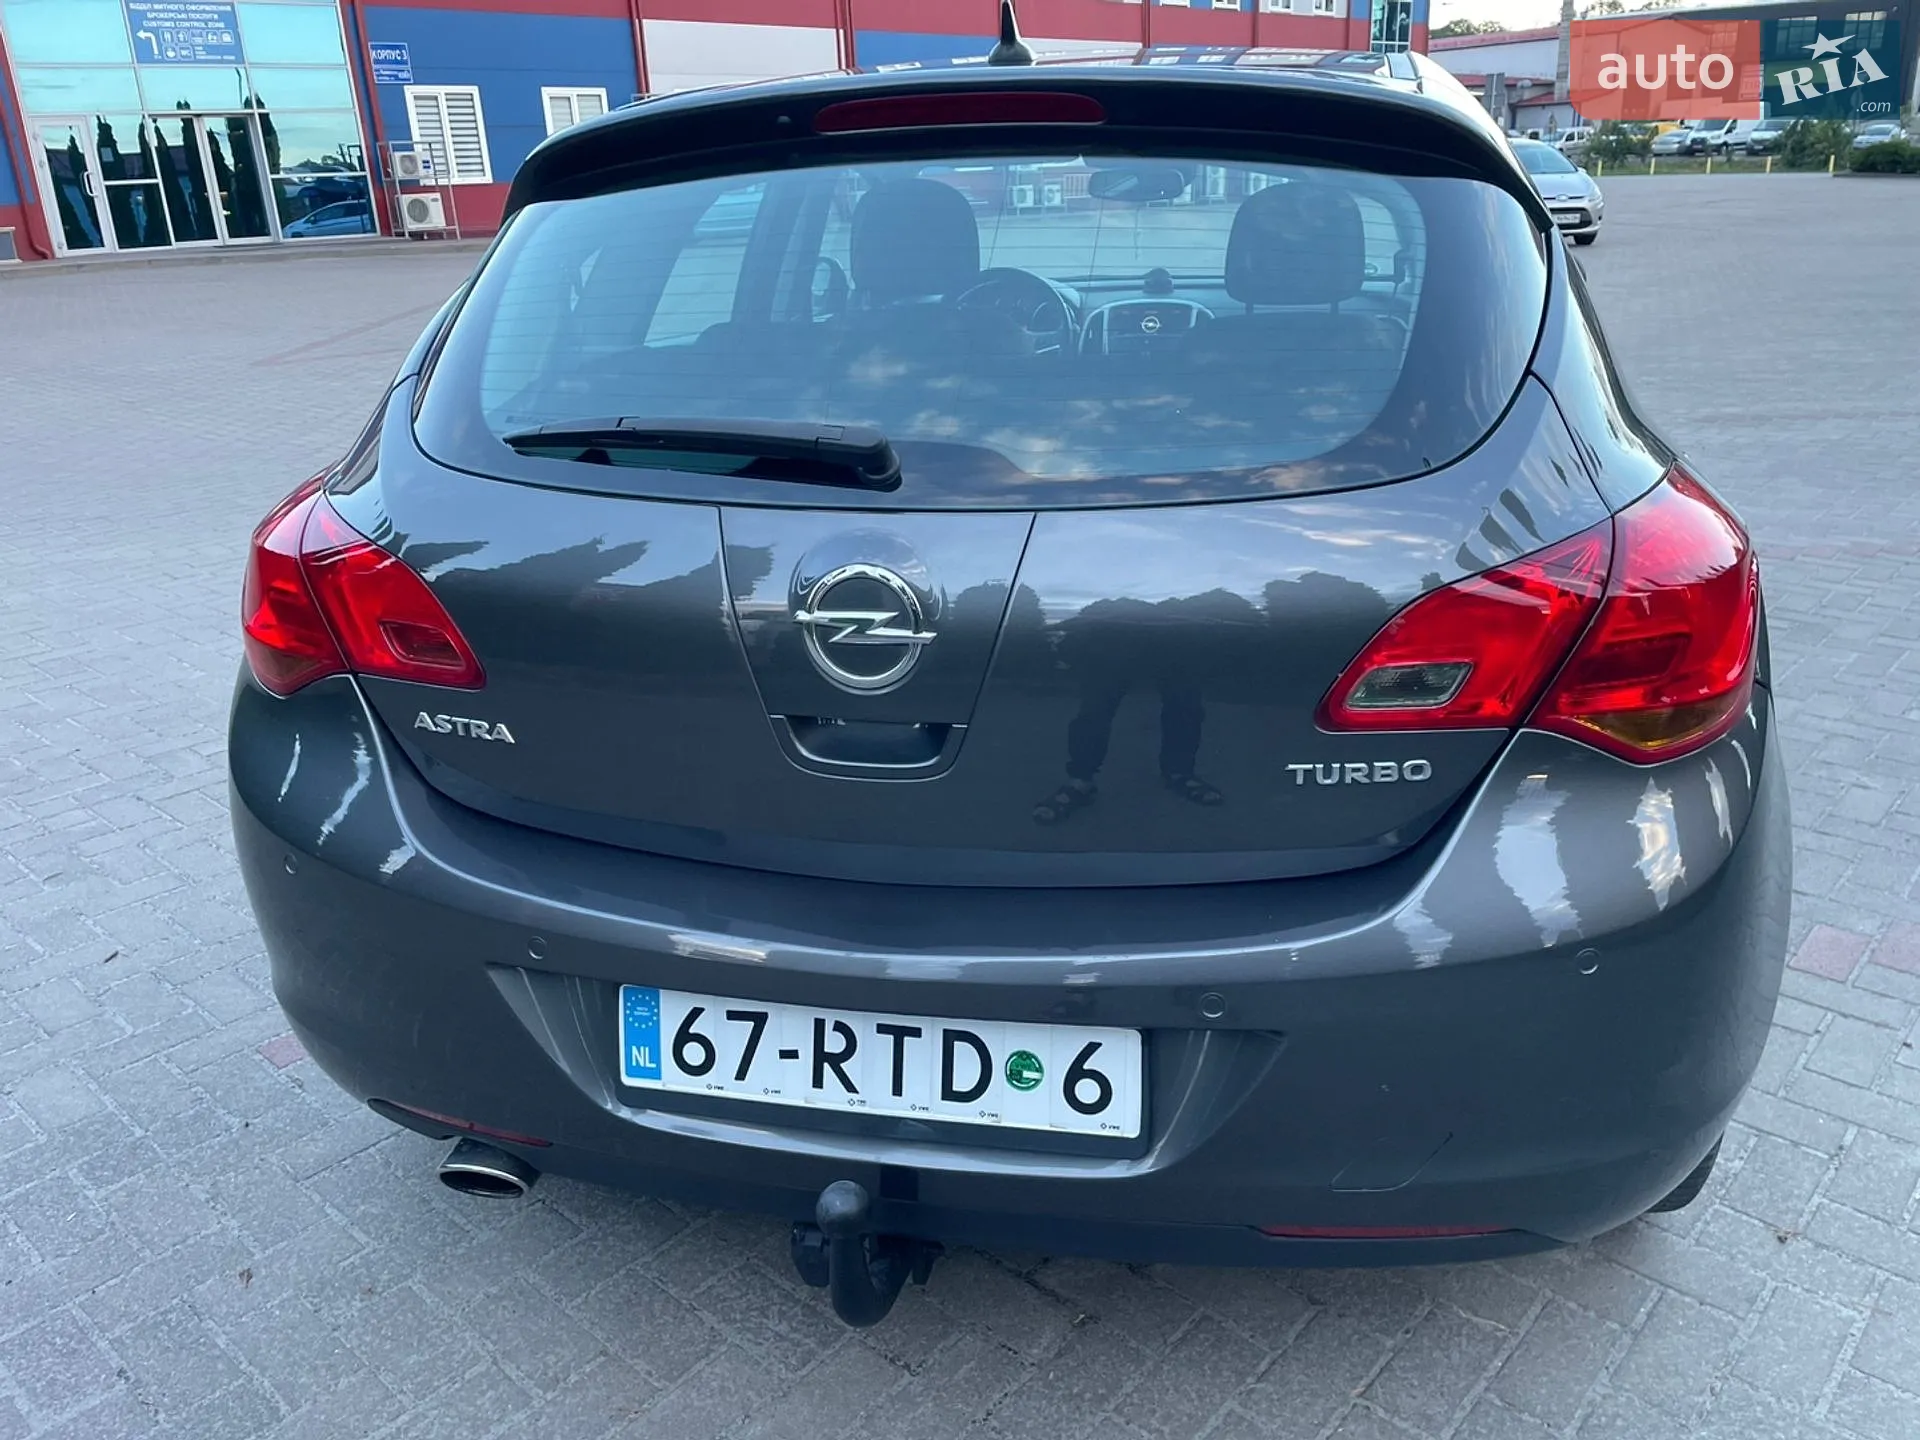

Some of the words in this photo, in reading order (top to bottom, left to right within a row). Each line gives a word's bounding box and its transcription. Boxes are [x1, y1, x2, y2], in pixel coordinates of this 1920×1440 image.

[372, 49, 401, 60] КОРПУС
[414, 711, 516, 744] ASTRA
[1285, 759, 1432, 785] TURBO
[631, 1045, 657, 1068] NL
